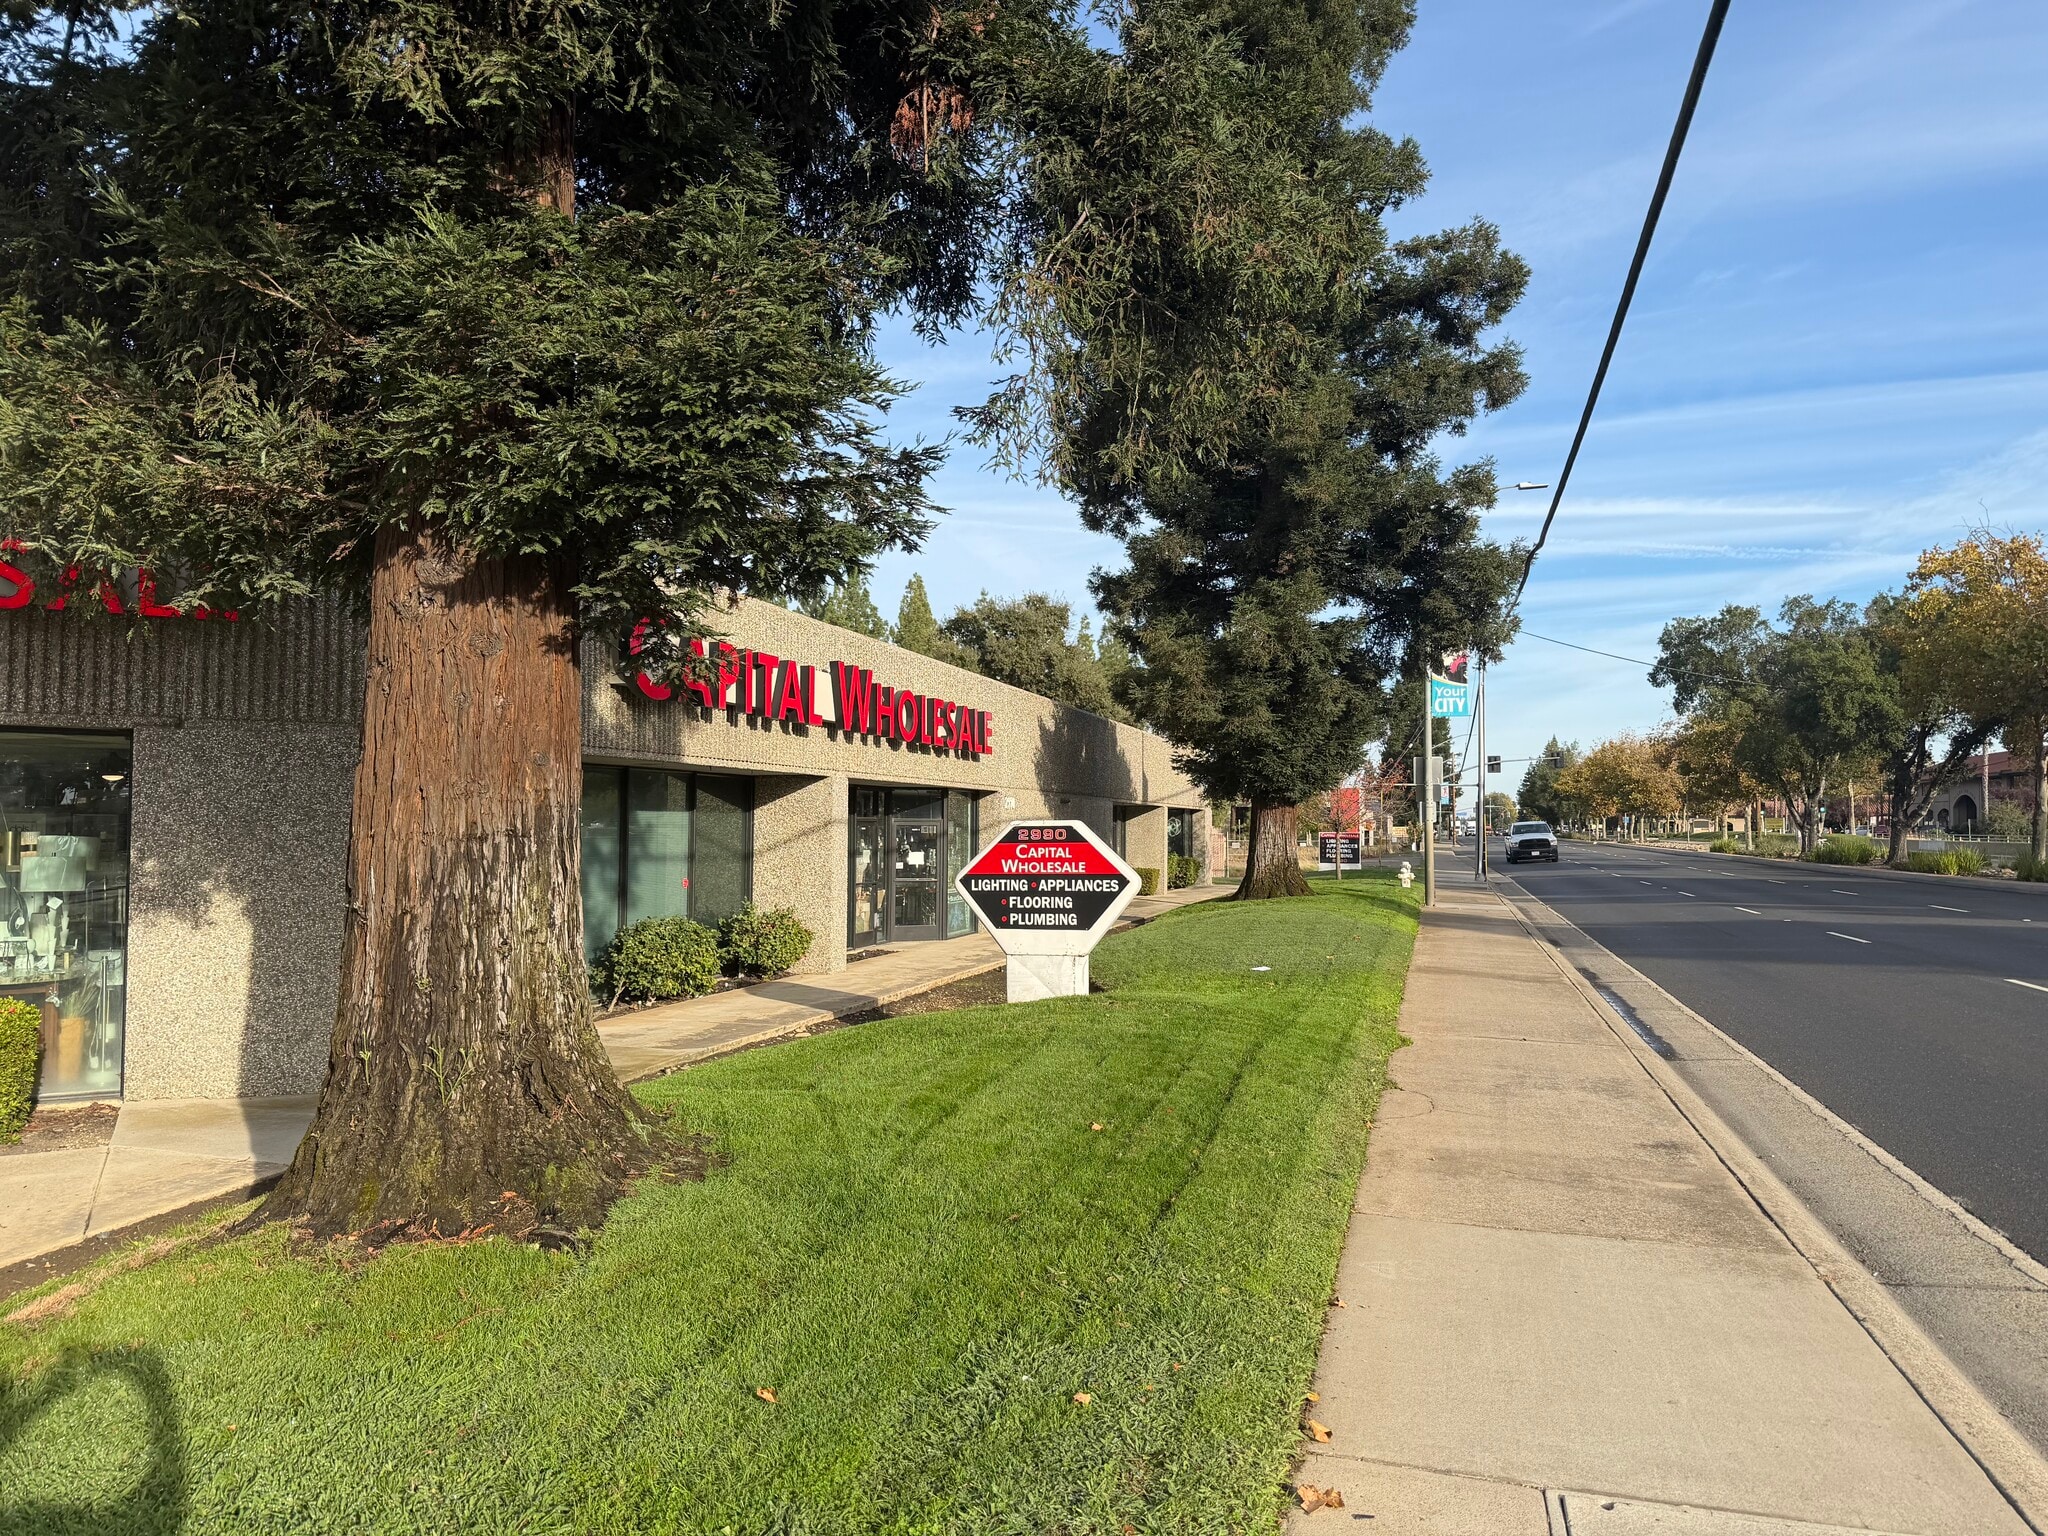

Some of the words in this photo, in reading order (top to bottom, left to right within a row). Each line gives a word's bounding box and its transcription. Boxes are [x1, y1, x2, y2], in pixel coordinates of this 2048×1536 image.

[629, 616, 823, 727] CAPITAL
[837, 660, 993, 755] WHOLESALE
[1435, 687, 1466, 697] Your
[1434, 698, 1466, 713] CITY
[1017, 828, 1067, 841] 2990
[1015, 844, 1072, 858] CAPITAL
[1001, 859, 1086, 873] WHOLESALE
[971, 879, 1028, 892] LIGHTING
[1038, 879, 1119, 892] APPLIANCES
[1009, 896, 1073, 909] FLOORING
[1010, 913, 1078, 926] PLUMBING
